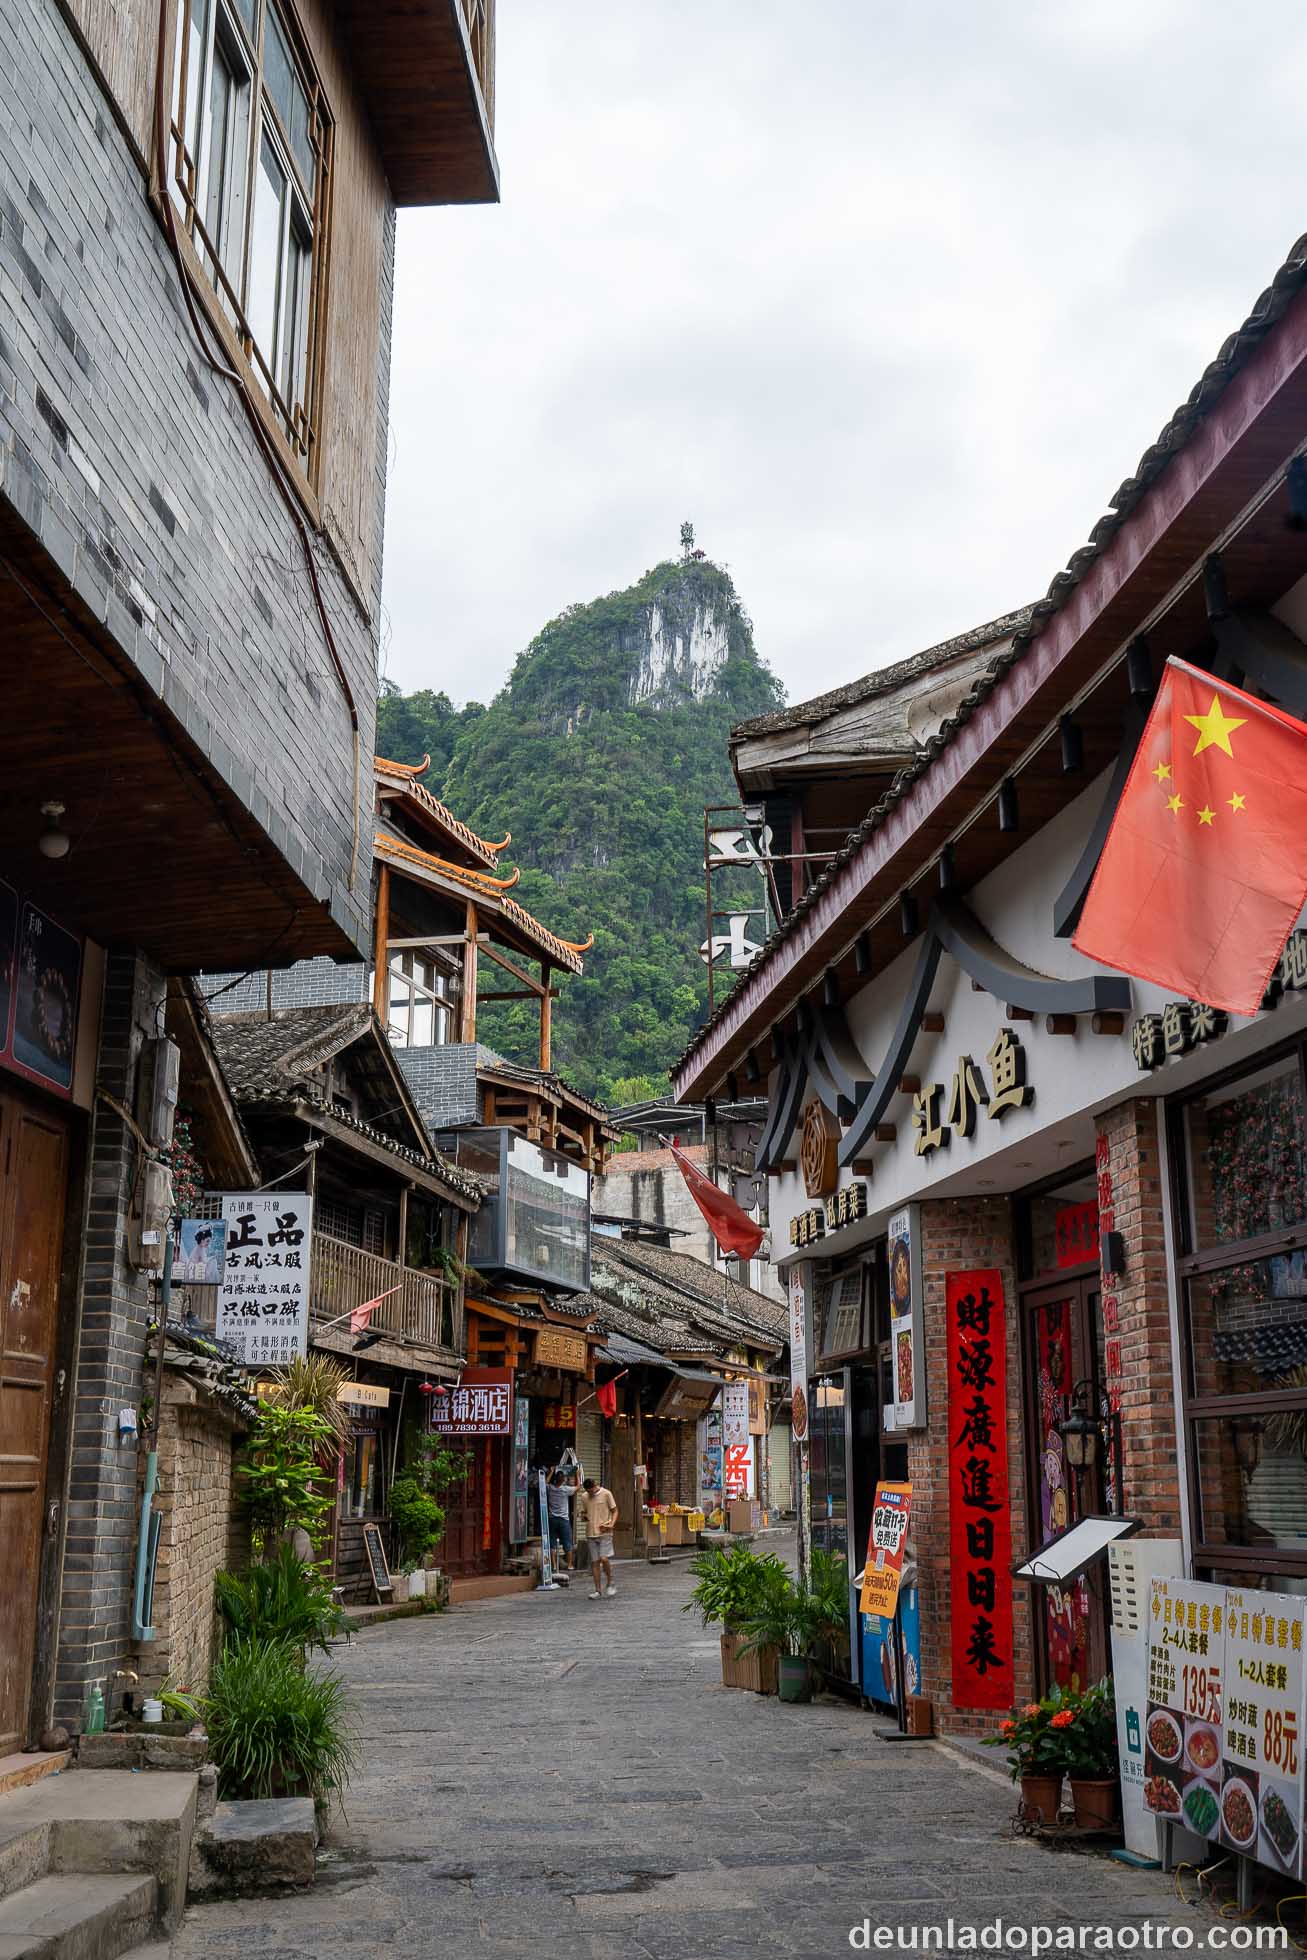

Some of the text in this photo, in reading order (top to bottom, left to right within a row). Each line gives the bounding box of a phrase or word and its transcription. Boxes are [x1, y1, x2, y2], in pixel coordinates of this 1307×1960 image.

[1132, 1001, 1214, 1067] 特色菜
[912, 1028, 1030, 1156] 江小鱼
[826, 1183, 861, 1229] 私房菜
[226, 1211, 305, 1250] 正品
[790, 1209, 820, 1246] 啤酒鱼
[225, 1250, 303, 1270] 古风汉服
[221, 1299, 300, 1319] 只做口碑
[431, 1387, 508, 1422] 盛锦酒店
[560, 1406, 573, 1420] 5
[478, 1423, 501, 1431] 3618
[873, 1507, 906, 1532] 收藏打卡
[876, 1529, 898, 1547] 免费送
[1151, 1594, 1223, 1634] 今日特惠套餐
[1228, 1608, 1303, 1652] 今日特惠套餐
[1150, 1645, 1170, 1662] 啤酒鱼
[1162, 1626, 1209, 1657] 2-4人套餐
[1238, 1658, 1287, 1691] 1-2人套餐
[1149, 1687, 1169, 1705] 炒时蔬
[1182, 1663, 1222, 1724] 139元
[1228, 1697, 1258, 1729] 炒时蔬
[1227, 1728, 1257, 1760] 啤酒鱼
[1263, 1708, 1298, 1775] 88元
